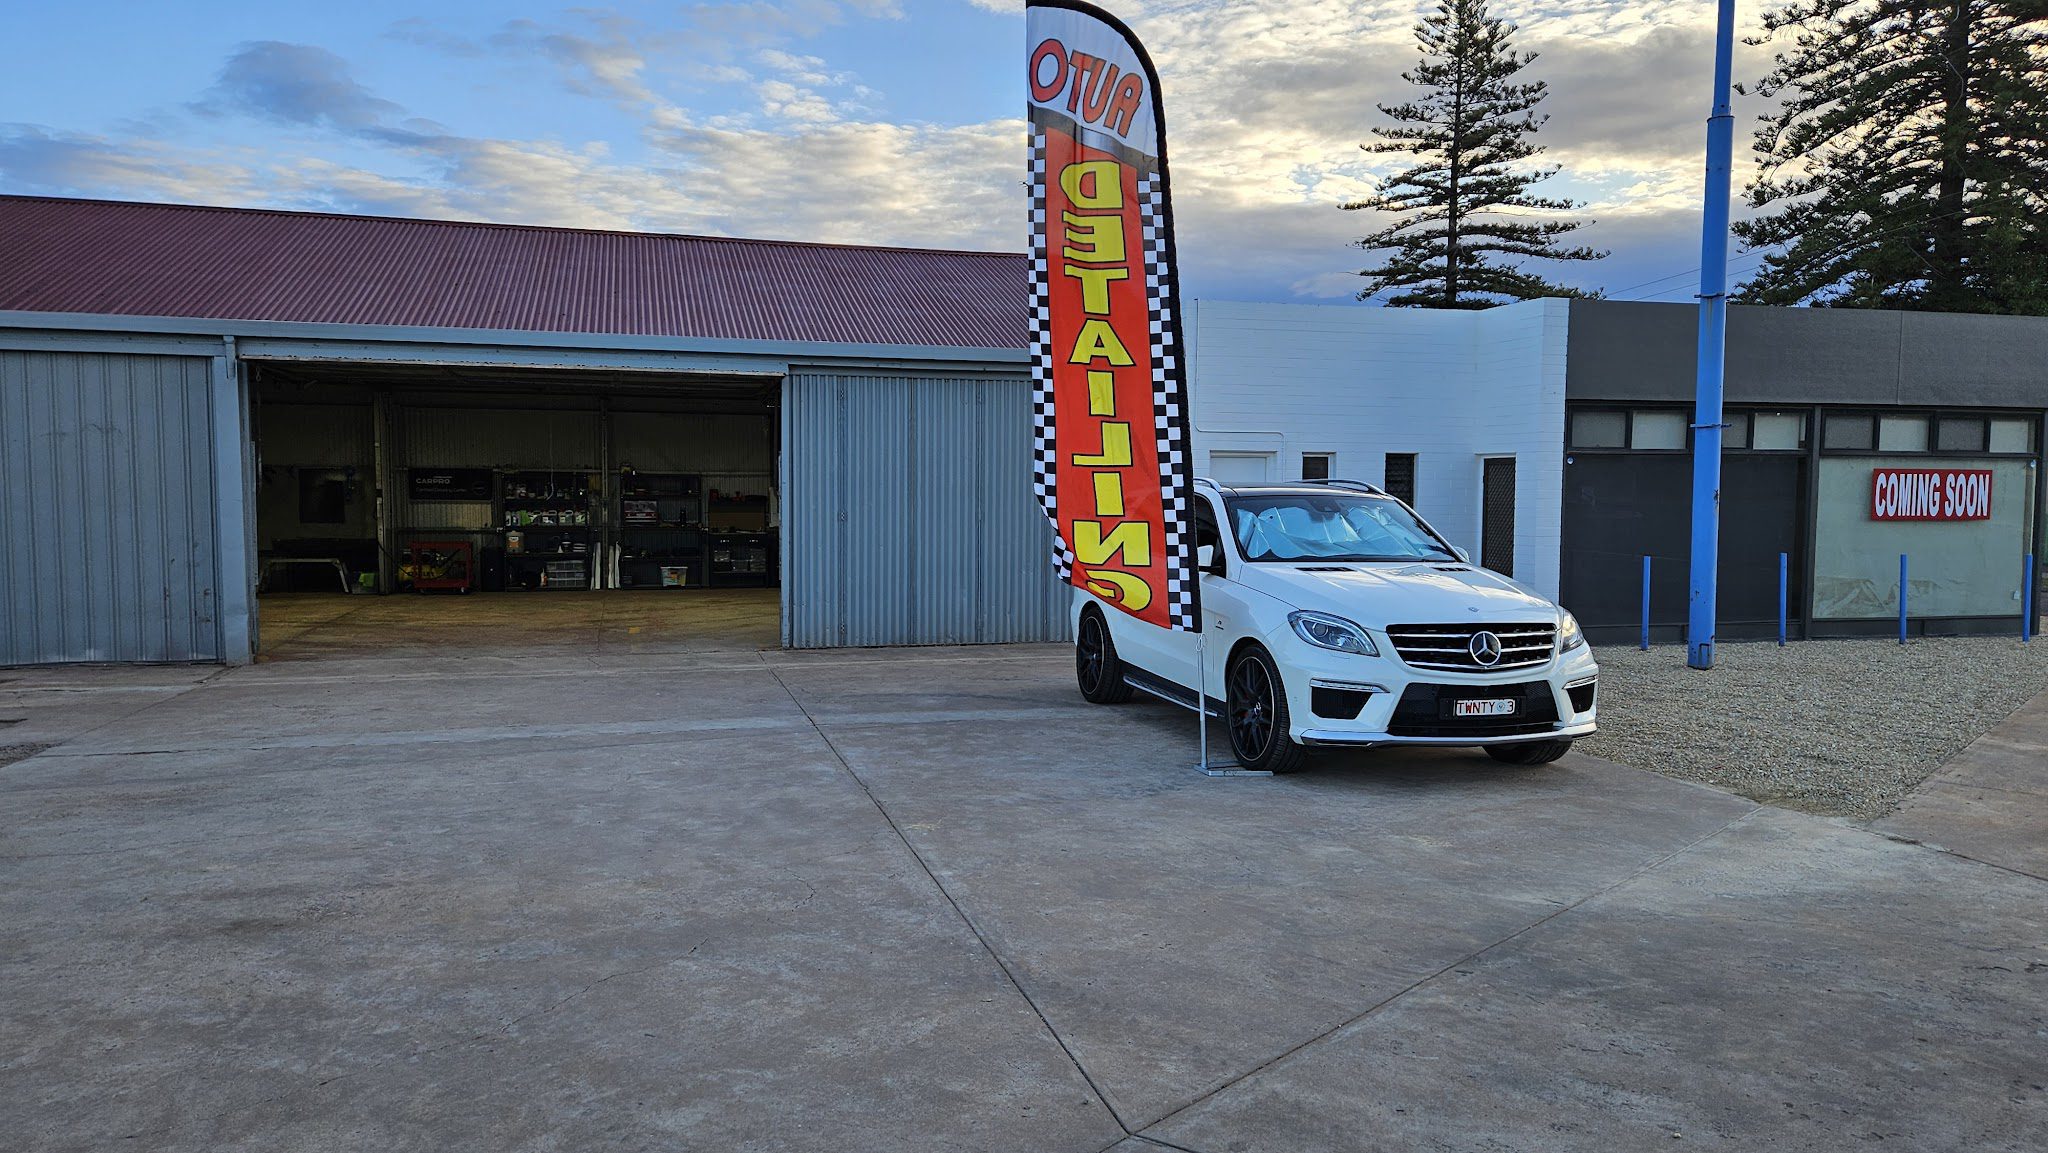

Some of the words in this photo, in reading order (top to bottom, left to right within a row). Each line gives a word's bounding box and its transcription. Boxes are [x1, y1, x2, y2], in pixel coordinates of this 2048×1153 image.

[1875, 472, 1941, 517] COMING
[1944, 473, 1990, 517] SOON
[1457, 702, 1496, 714] TWNTY
[1507, 700, 1514, 713] 3
